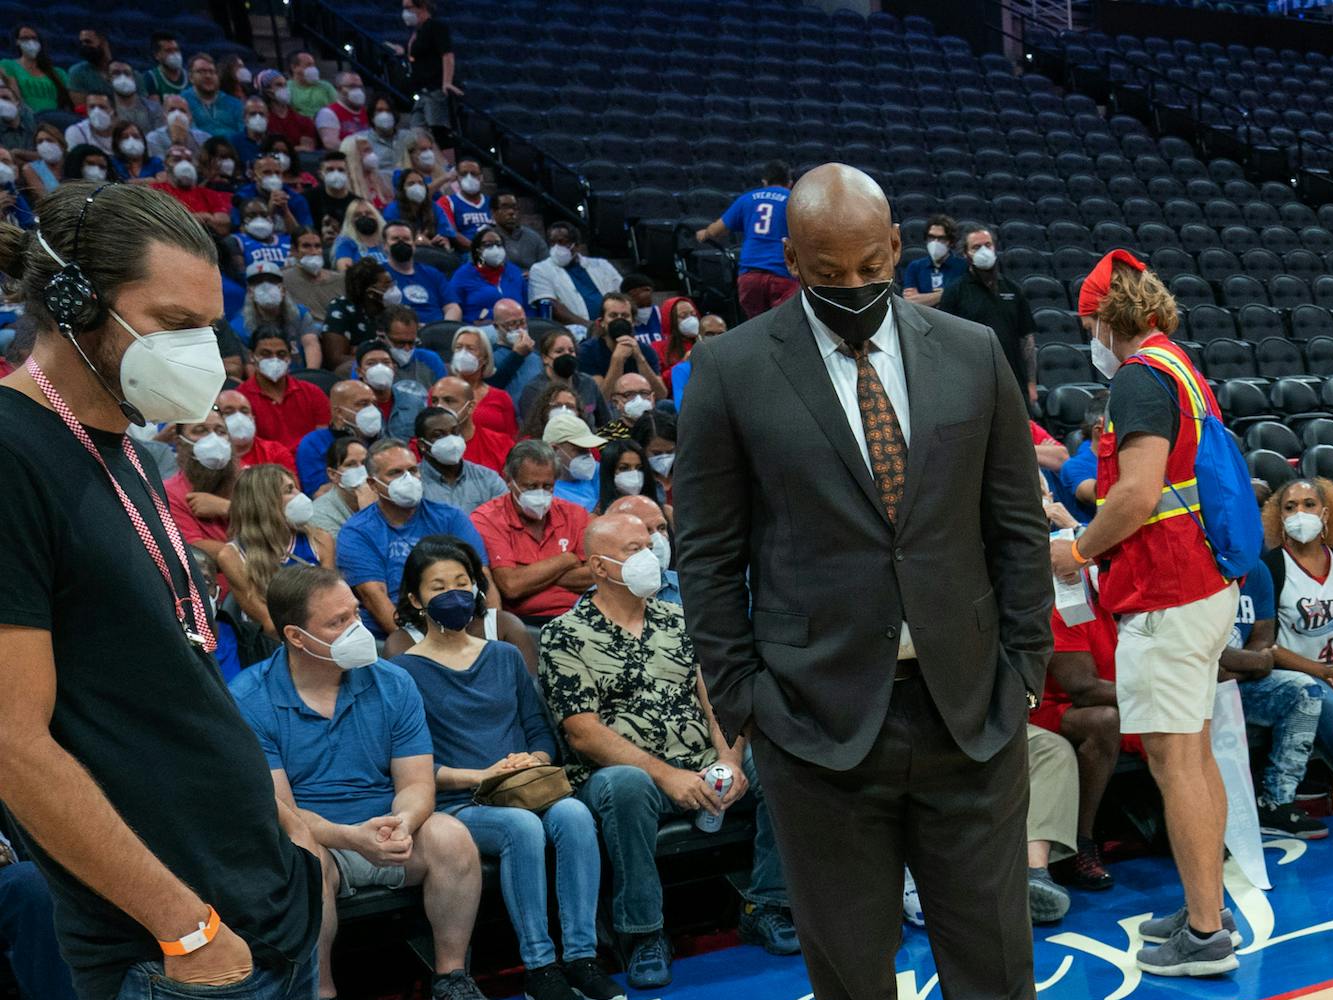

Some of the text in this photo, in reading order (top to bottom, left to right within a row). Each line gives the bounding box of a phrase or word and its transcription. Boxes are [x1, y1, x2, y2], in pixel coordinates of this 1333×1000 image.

[752, 191, 787, 203] IVERSON
[754, 203, 774, 235] 3
[251, 247, 290, 264] PHIL
